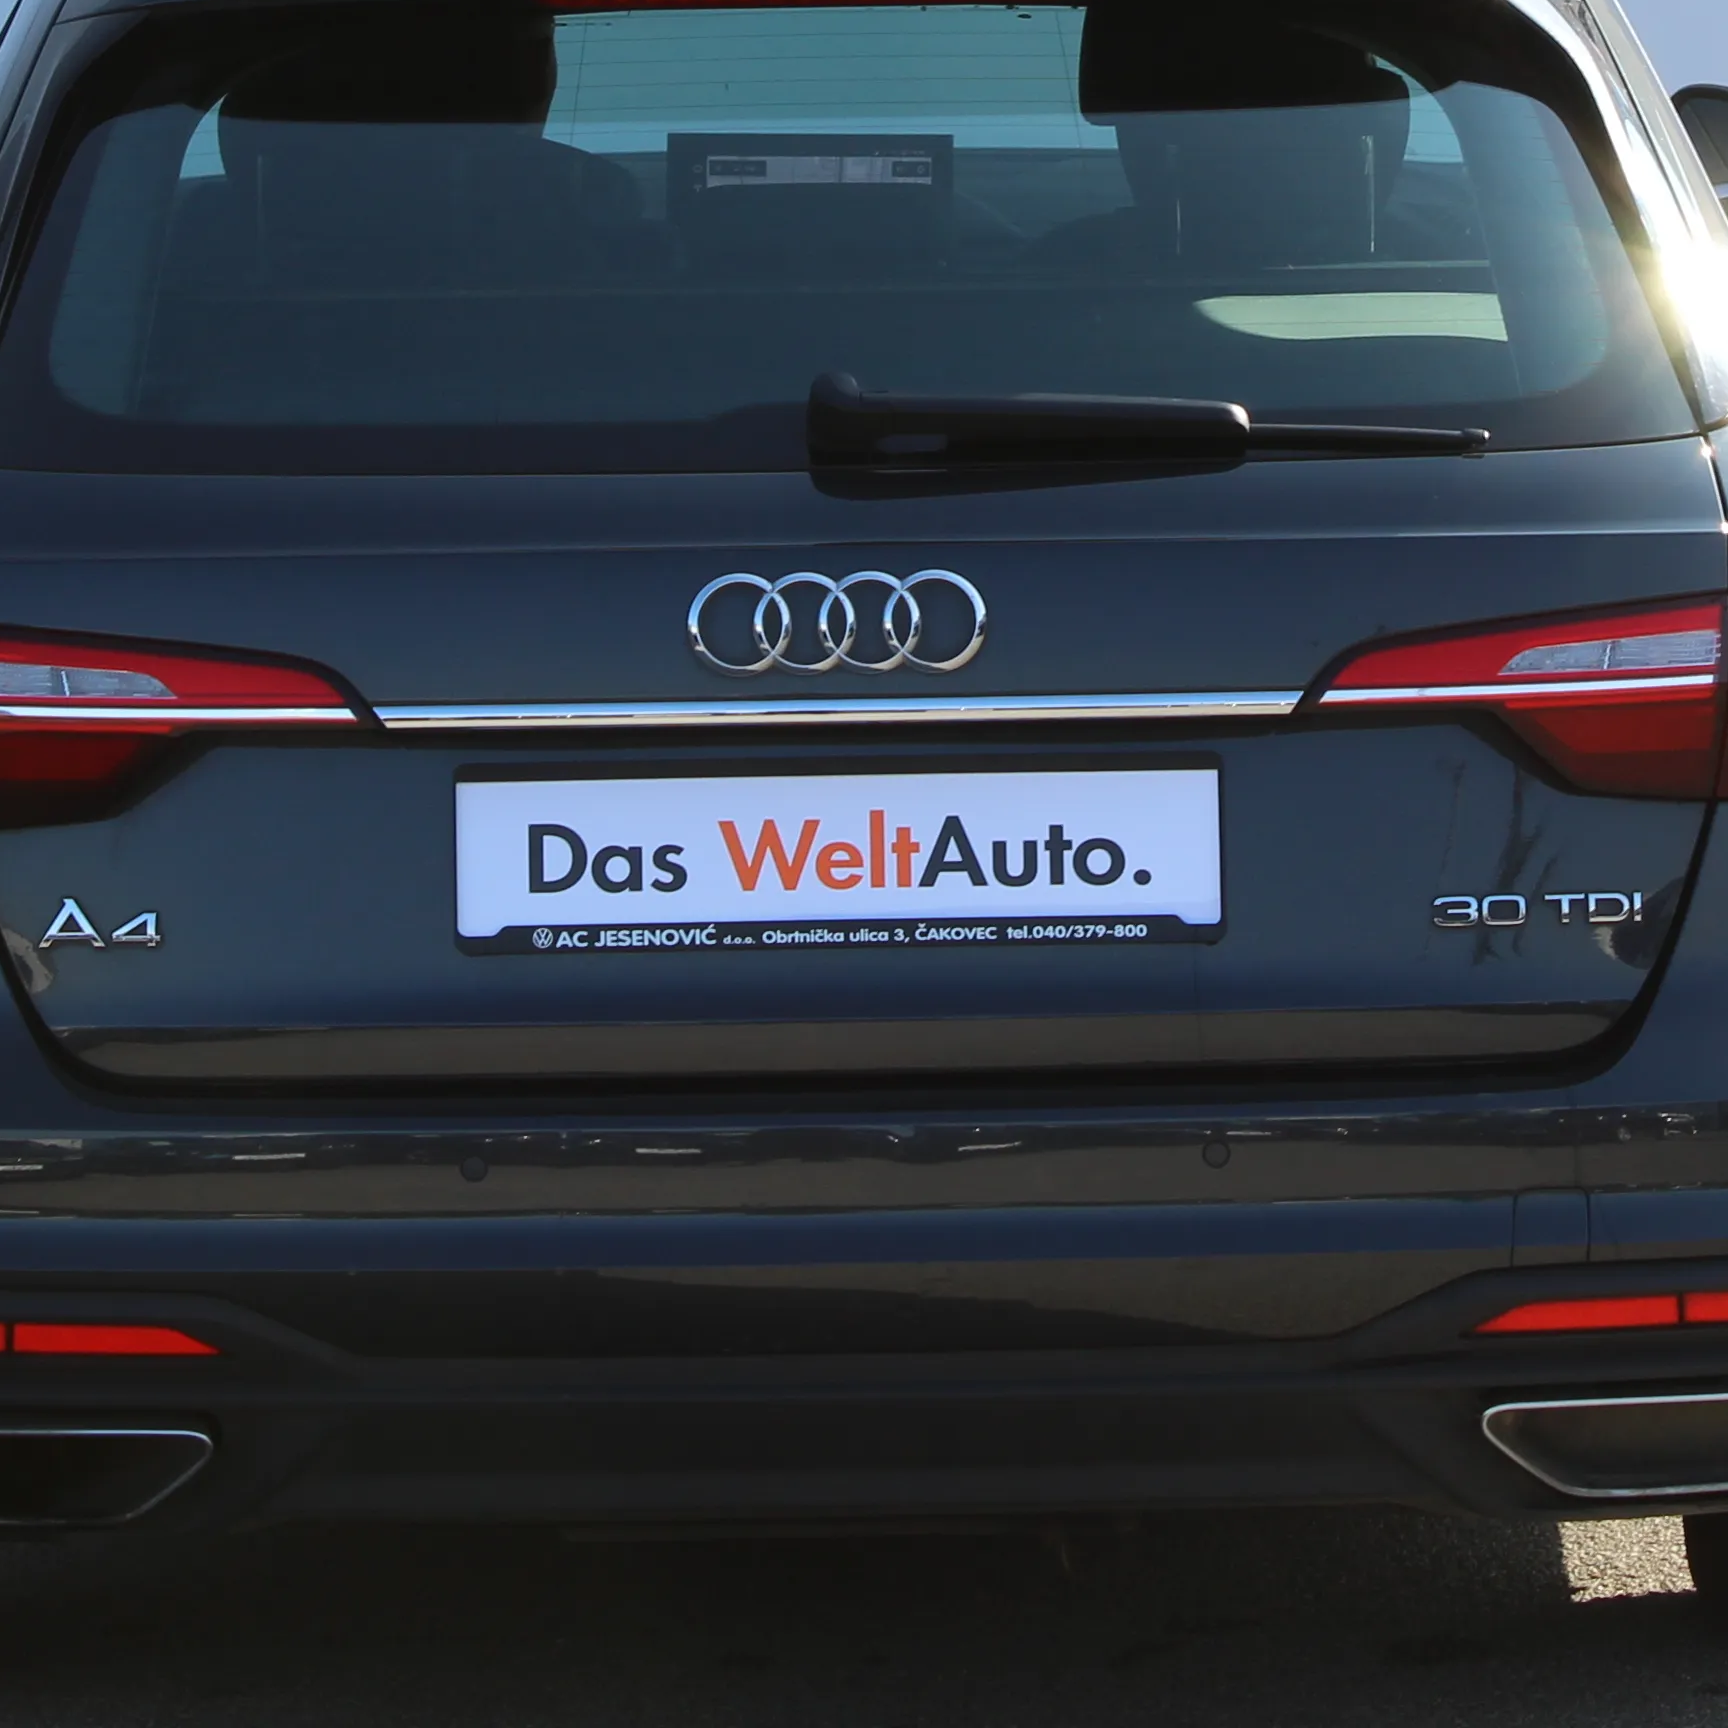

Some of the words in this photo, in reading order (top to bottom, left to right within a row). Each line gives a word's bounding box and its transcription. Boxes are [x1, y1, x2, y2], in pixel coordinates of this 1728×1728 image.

[527, 823, 689, 894] Das
[718, 809, 1153, 892] WeltAuto.
[38, 897, 161, 949] A4
[1432, 894, 1527, 928] 30
[1544, 891, 1643, 924] TDI
[555, 930, 589, 948] AC
[593, 923, 717, 947] JESENOVIĆ
[722, 934, 757, 945] d.o.o.
[761, 928, 845, 944] Obrtnička
[849, 928, 889, 943] ulica
[893, 928, 910, 943] 3,
[914, 922, 998, 941] ČAKOVEC
